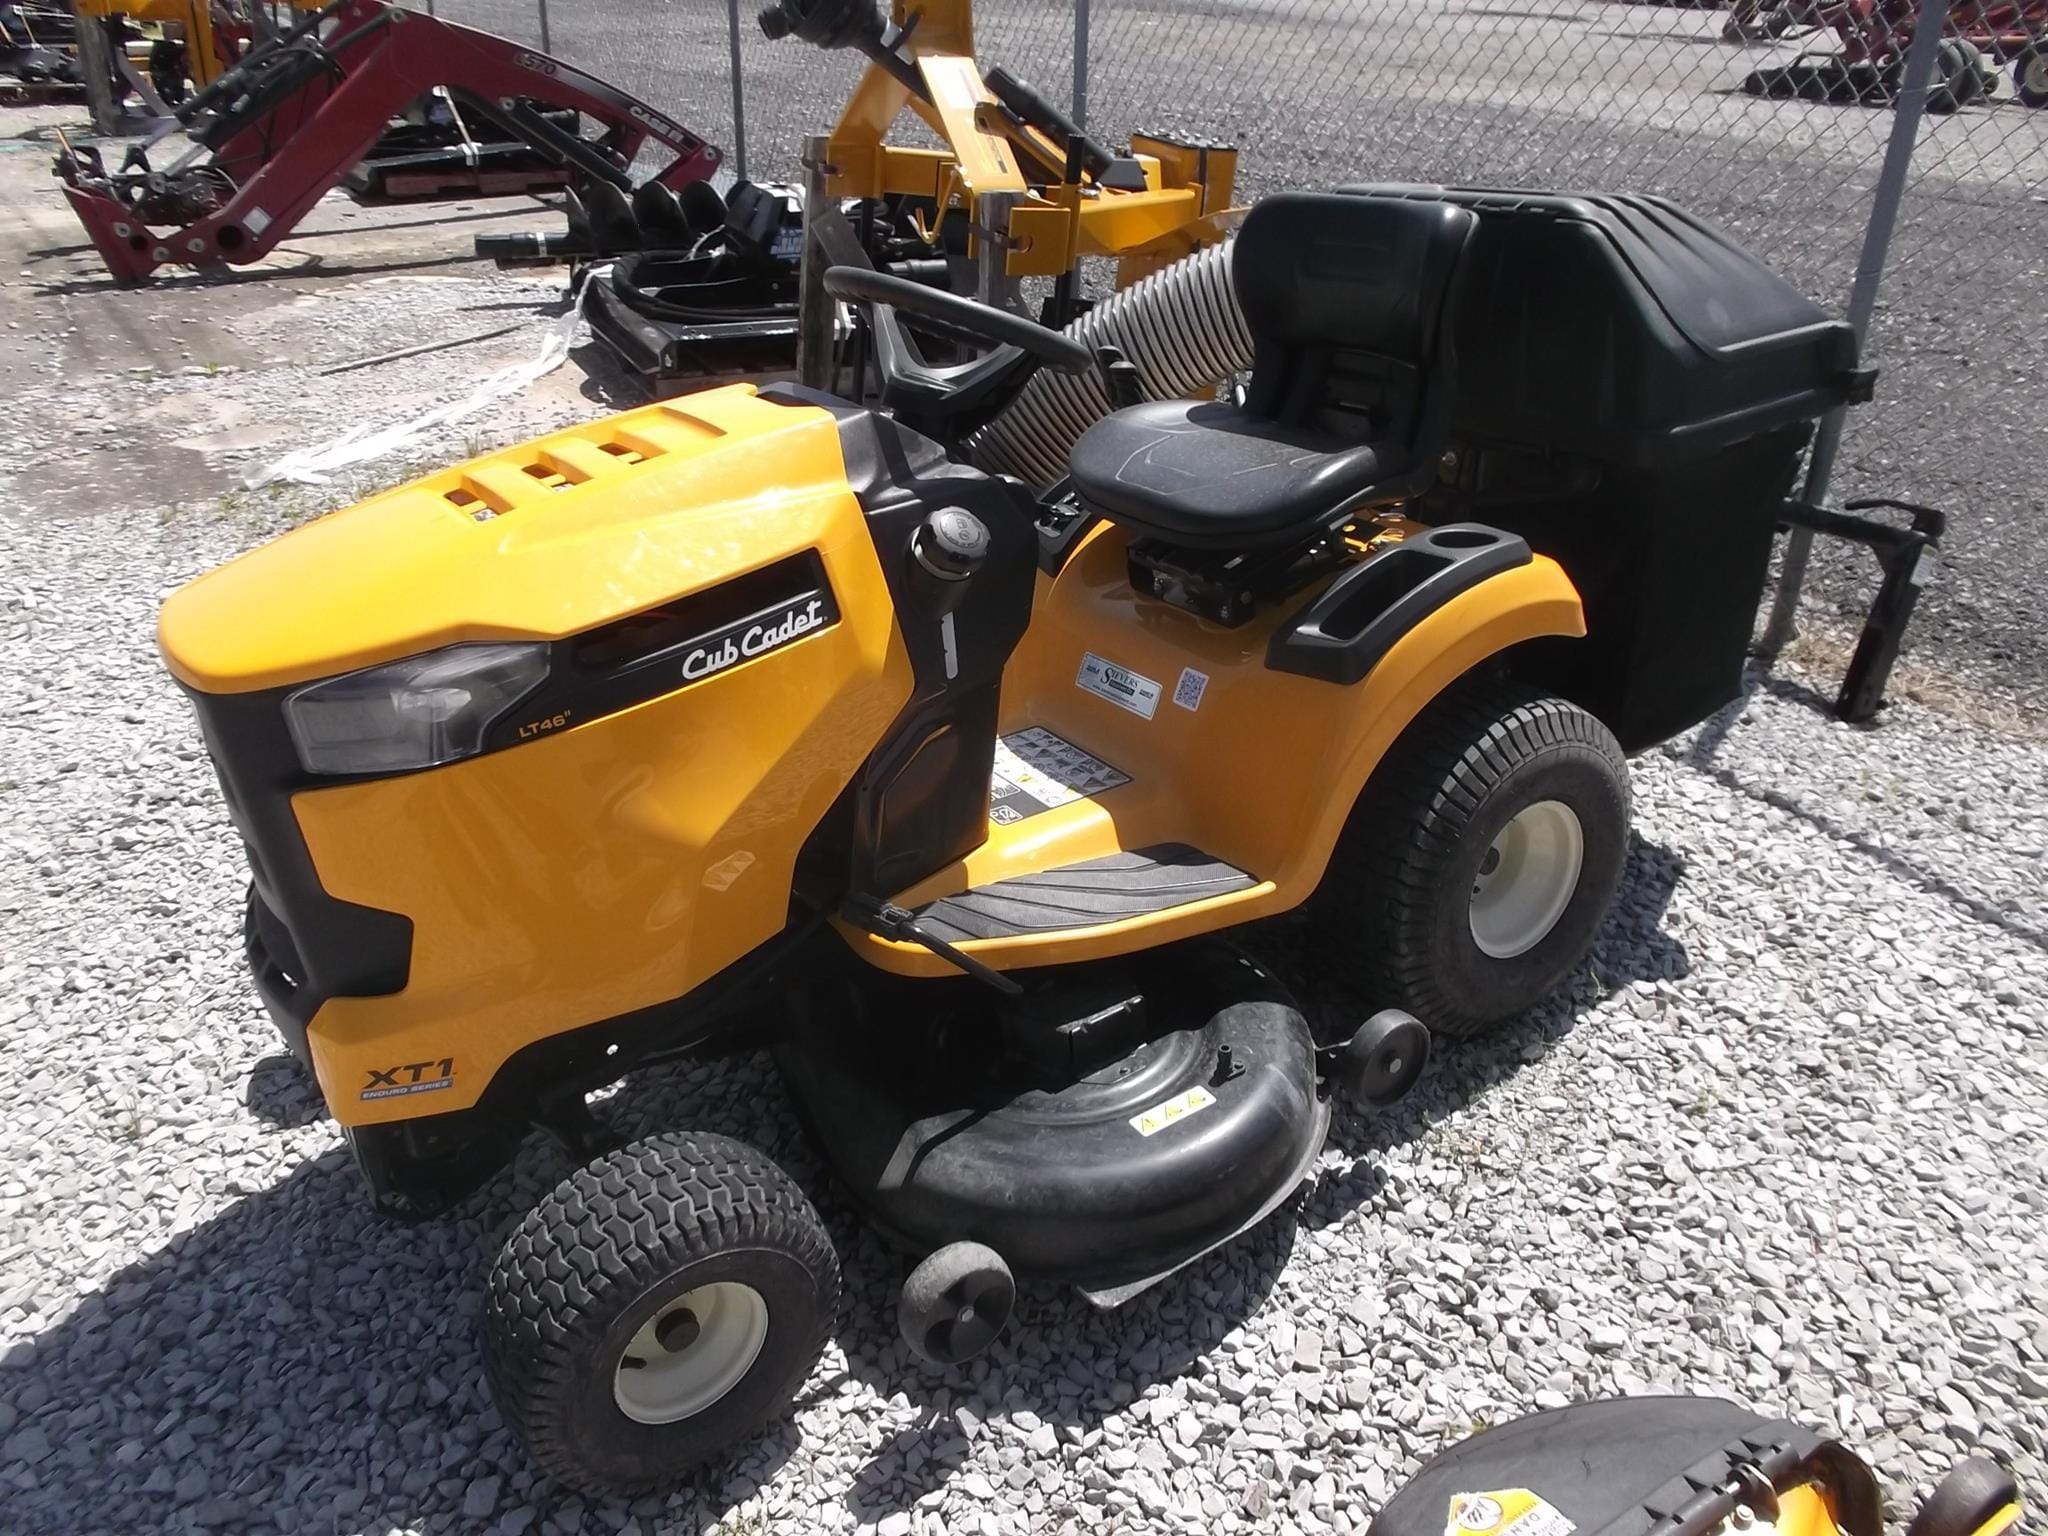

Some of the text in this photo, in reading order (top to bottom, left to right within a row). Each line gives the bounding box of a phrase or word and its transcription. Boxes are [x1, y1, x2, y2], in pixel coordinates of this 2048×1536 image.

[682, 600, 823, 680] Cub Cadet
[518, 709, 572, 738] LT46"
[362, 1057, 455, 1090] XT1
[362, 1080, 450, 1099] ENDURO SERIES
